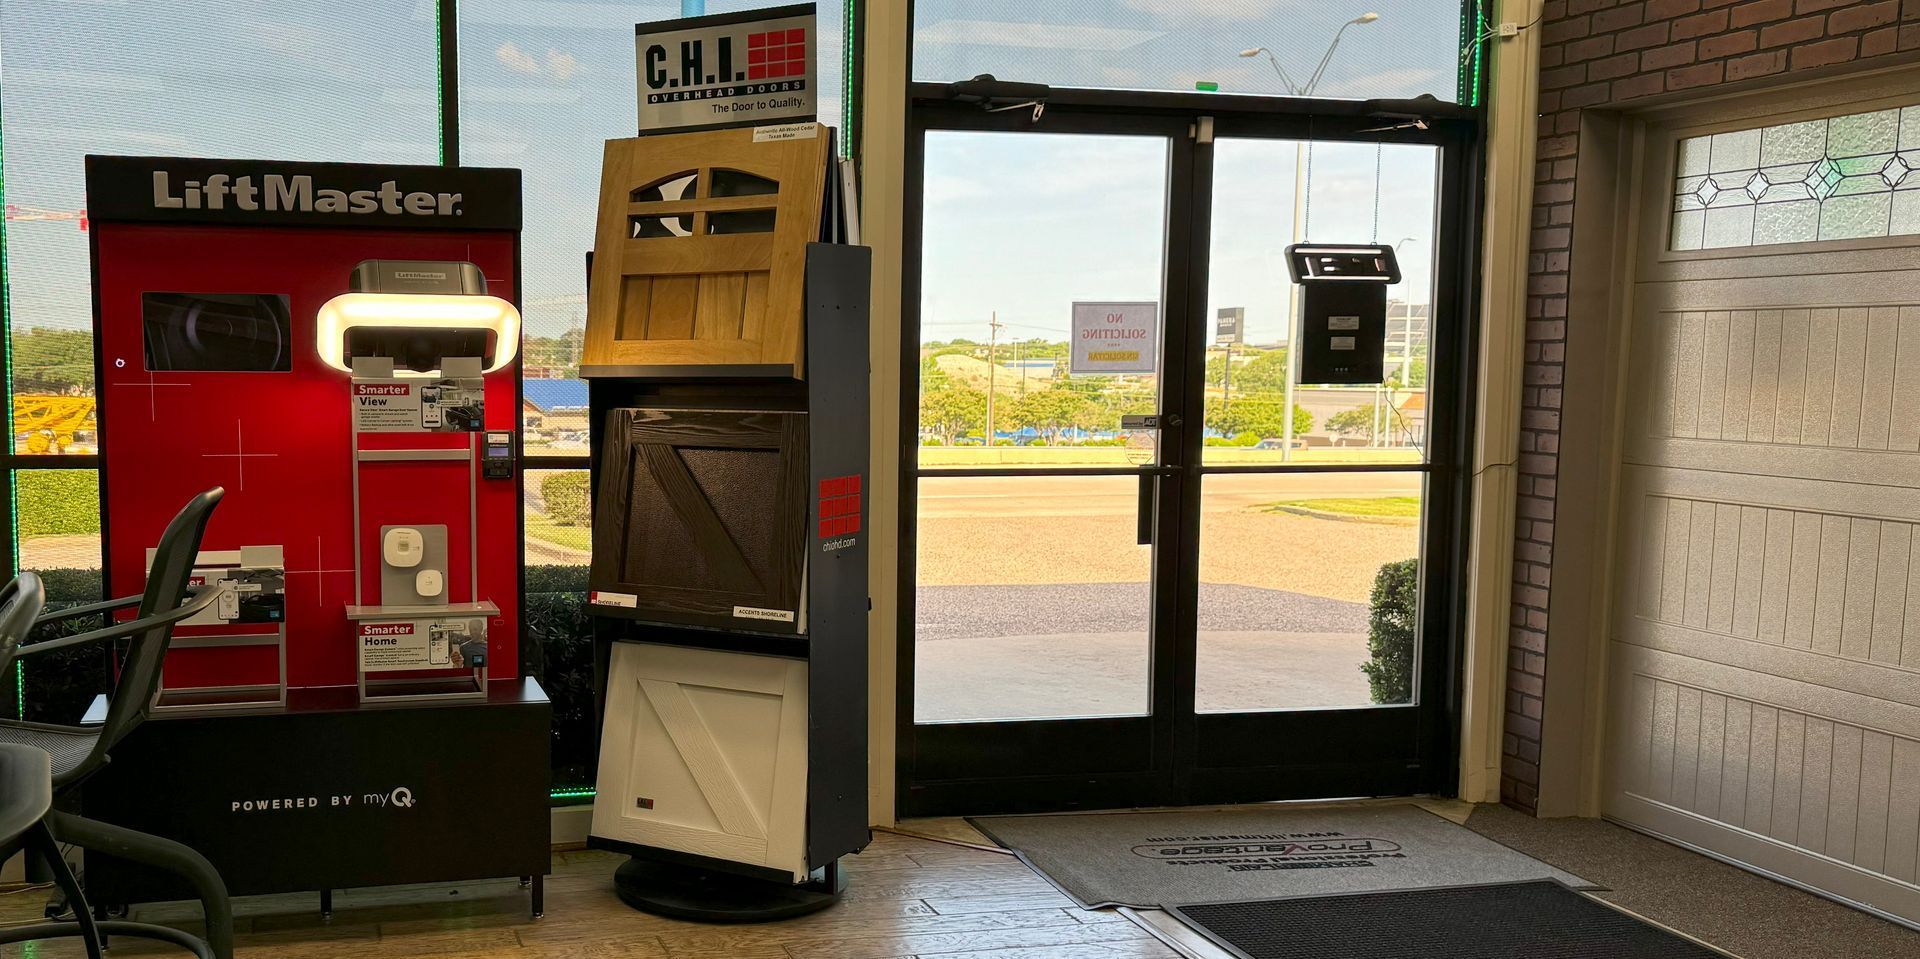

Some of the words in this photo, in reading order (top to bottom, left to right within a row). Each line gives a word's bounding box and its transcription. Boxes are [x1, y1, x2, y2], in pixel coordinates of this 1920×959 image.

[646, 36, 745, 89] C.H.I.
[651, 88, 735, 103] OVERHEAD
[747, 81, 801, 94] DOORS
[712, 104, 729, 113] The
[732, 102, 754, 112] Door
[756, 101, 766, 110] to
[769, 96, 805, 108] Quality.
[153, 170, 462, 216] LiftMaster
[359, 384, 406, 395] Smarter
[359, 397, 388, 406] View
[823, 537, 856, 551] chiohd.com
[364, 625, 411, 635] Smarter
[364, 637, 398, 646] Home
[232, 797, 318, 812] POWERED
[332, 795, 352, 806] BY
[364, 786, 412, 808] myQ
[1165, 857, 1268, 865] Products
[1269, 853, 1407, 862] Professional
